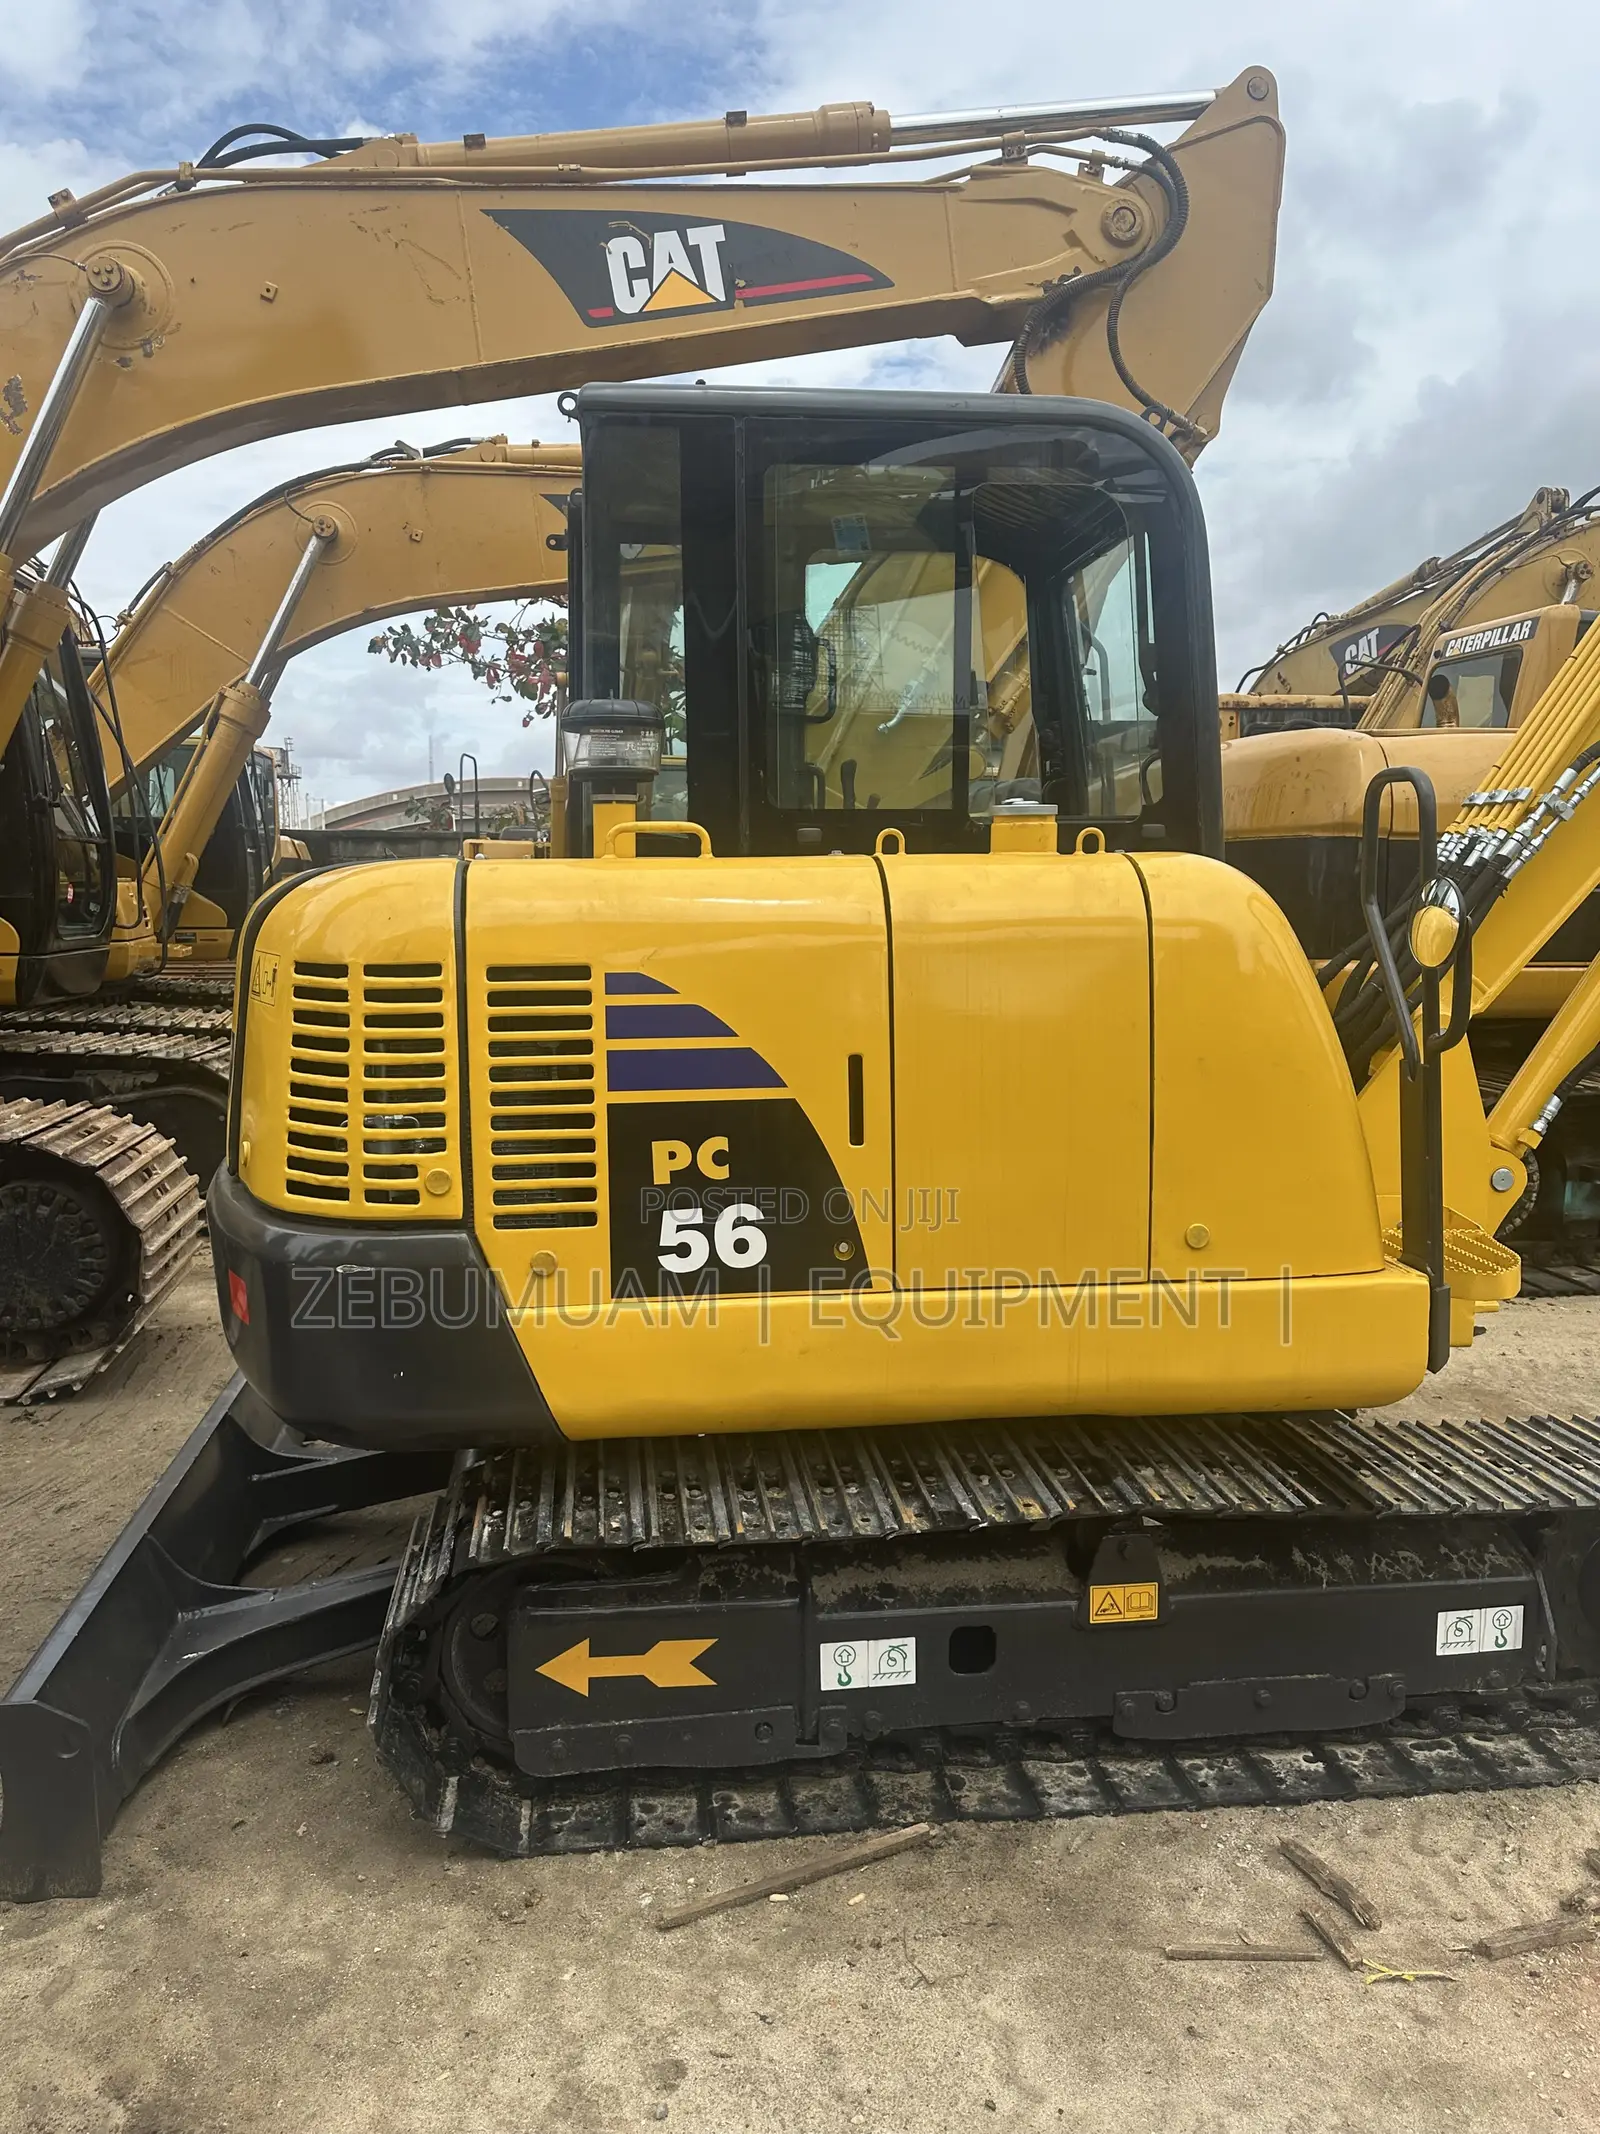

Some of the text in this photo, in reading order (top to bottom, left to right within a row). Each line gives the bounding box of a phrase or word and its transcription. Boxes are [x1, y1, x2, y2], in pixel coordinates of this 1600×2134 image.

[605, 224, 726, 314] CAT
[1345, 627, 1379, 675] CAT
[1445, 620, 1532, 658] CATERPILLAR
[651, 1136, 730, 1185] PC
[657, 1203, 767, 1274] 56
